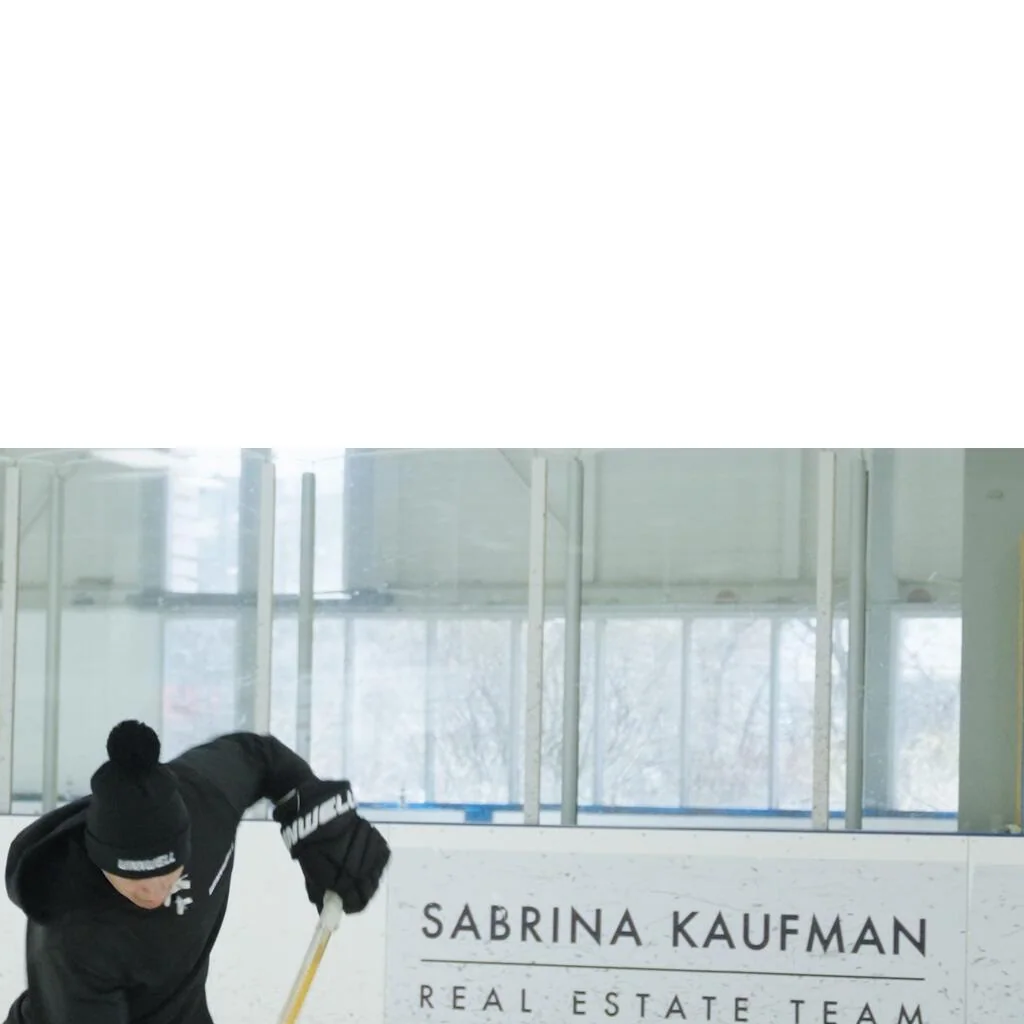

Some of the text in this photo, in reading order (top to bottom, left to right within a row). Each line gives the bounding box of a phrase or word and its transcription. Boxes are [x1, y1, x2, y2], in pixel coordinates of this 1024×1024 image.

[421, 902, 927, 957] SABRINA KAUFMAN
[420, 984, 533, 1014] REAL
[573, 990, 750, 1023] ESTATE
